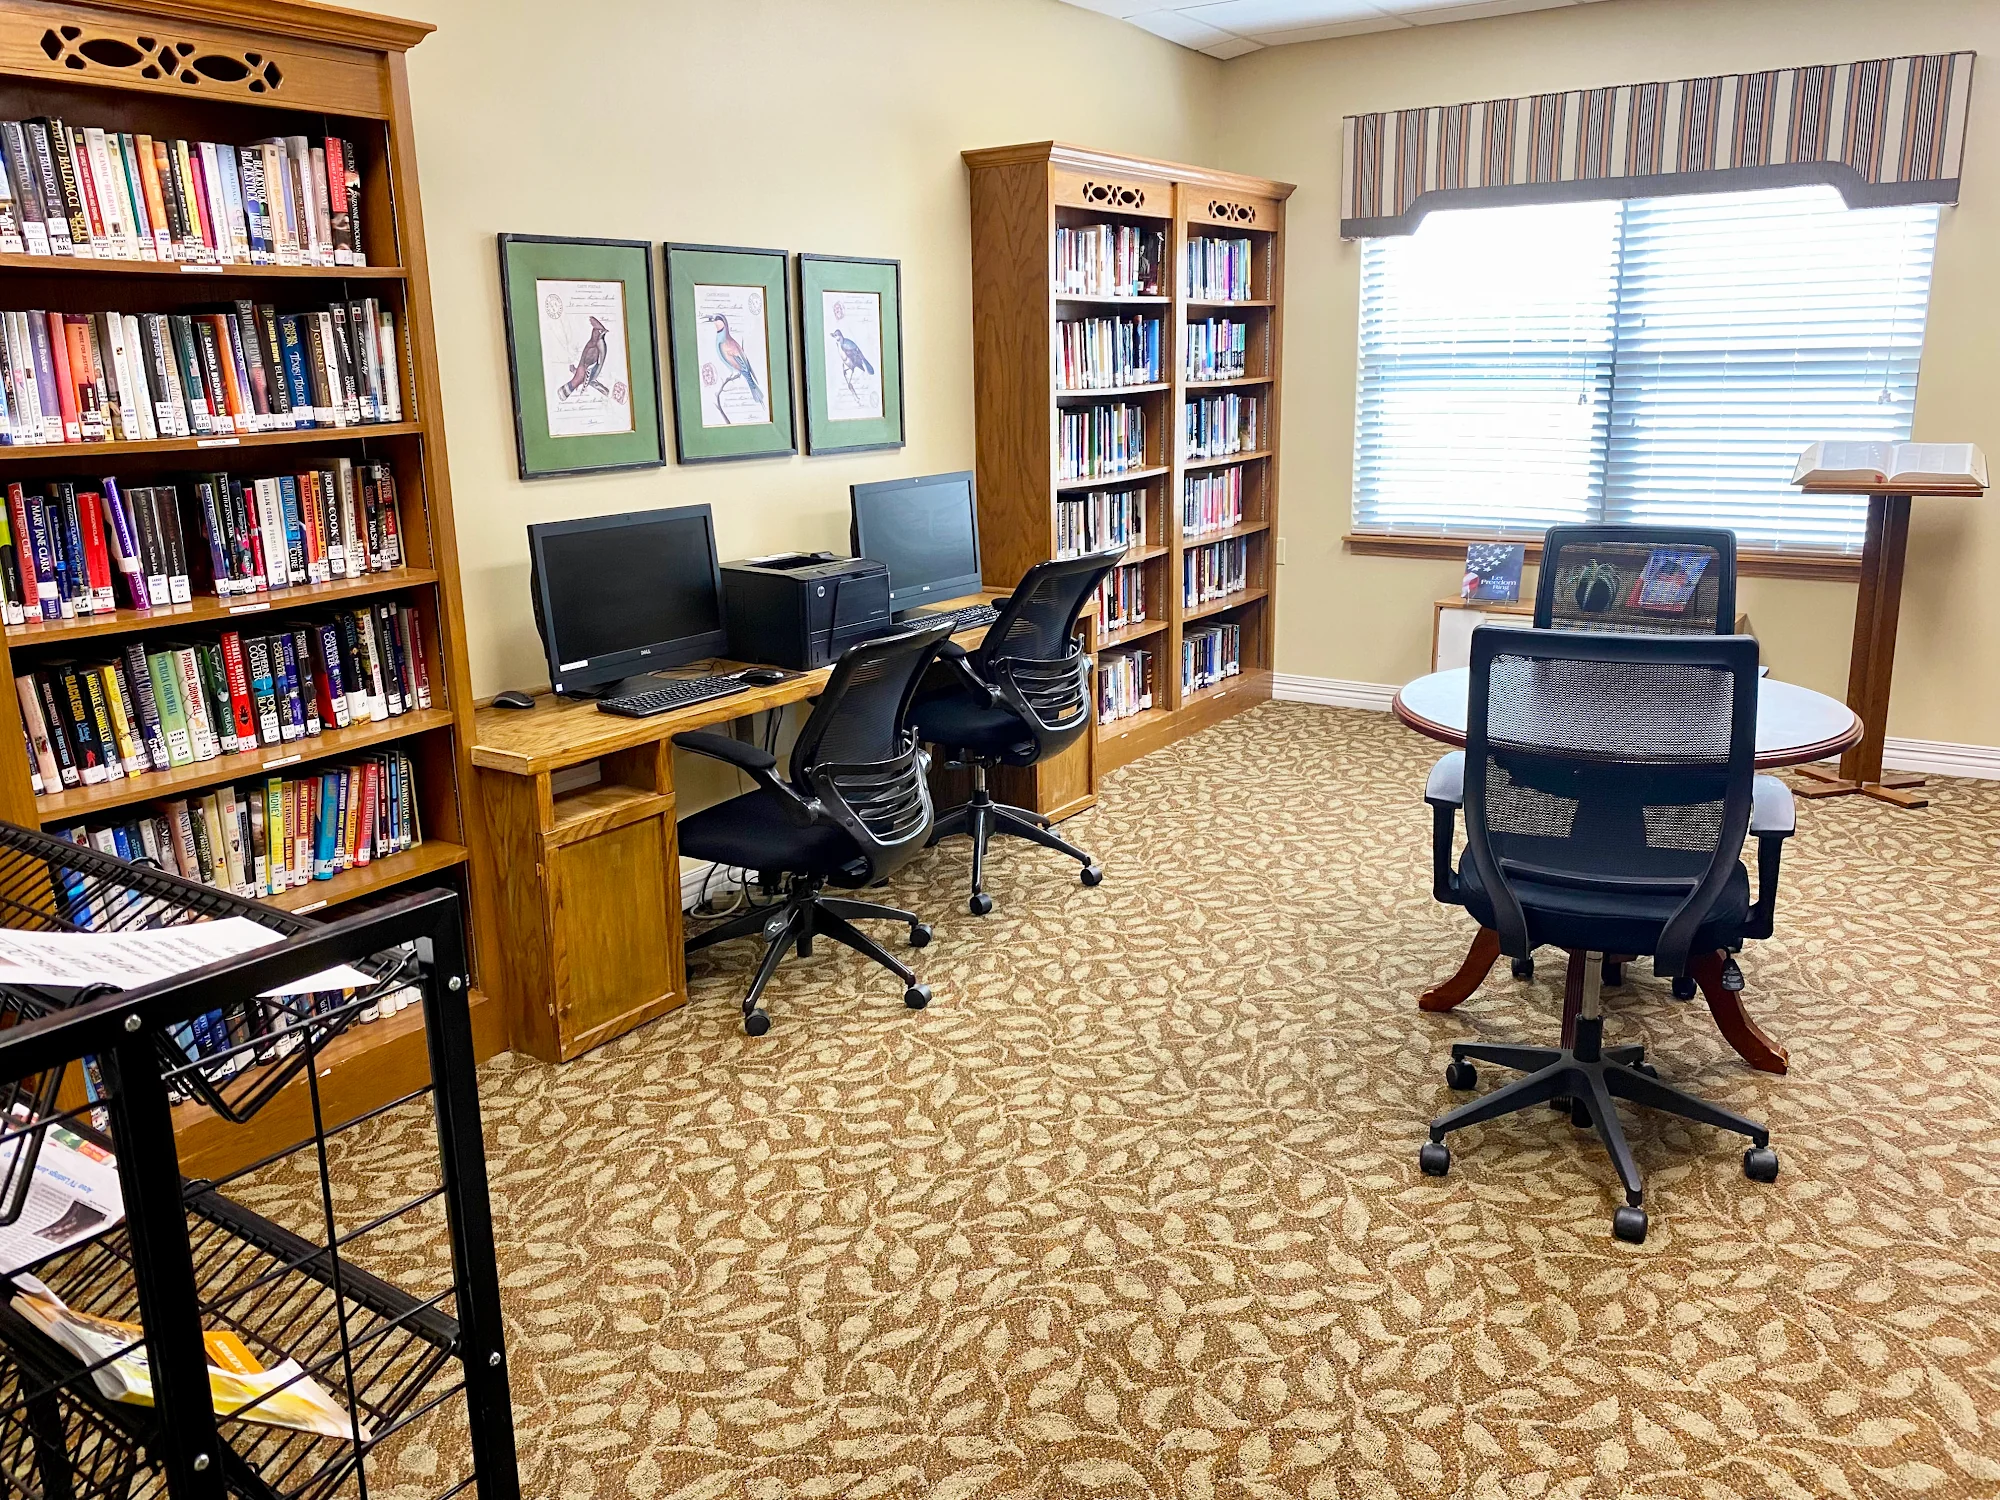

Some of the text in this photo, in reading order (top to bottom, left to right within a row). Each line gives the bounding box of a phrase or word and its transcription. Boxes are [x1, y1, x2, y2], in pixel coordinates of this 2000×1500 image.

[14, 153, 31, 190] BALDACCI
[33, 126, 57, 197] DAVID BALDACCI
[51, 120, 80, 207] DAVID BALDACCI
[241, 151, 258, 202] BLACKSTOCK
[253, 160, 268, 204] BLACKSTOCK
[339, 167, 347, 210] BOHJALIAN
[104, 184, 116, 216] BELGRAVIA
[74, 211, 90, 243] SPLIT
[159, 319, 169, 348] SANDRA
[240, 303, 256, 336] SANDRA
[267, 320, 277, 342] SANDRA
[91, 340, 99, 368] BROWNE
[164, 350, 175, 376] BROWN
[247, 338, 262, 368] BROWN
[270, 342, 280, 363] BROWN
[311, 328, 326, 374] JOURNEY
[204, 337, 216, 370] SANDRA
[212, 372, 224, 401] BROWN
[274, 365, 286, 390] BLIND
[168, 379, 180, 403] white
[67, 504, 75, 527] HIGGINS
[282, 479, 297, 531] HARLAN COBEN
[324, 474, 339, 537] ROBIN COOK
[13, 489, 39, 605] Carol Higgins Clark MOBBED
[31, 505, 51, 573] MARY JANE CLARK
[289, 548, 299, 569] CURE
[128, 647, 147, 683] PATRICIA
[248, 645, 262, 681] COULTER
[257, 643, 271, 679] CATHERINE
[272, 642, 286, 677] COULTER
[295, 635, 304, 660] COULTER
[325, 633, 335, 668] COULTER
[329, 630, 340, 665] CATHERINE
[229, 635, 247, 696] MICHAEL CRICHTON
[42, 683, 53, 702] MICHAEL
[64, 676, 78, 702] BLACK
[156, 655, 178, 716] PATRICIA CORNWELL
[182, 652, 201, 716] PATRICIA CORNWELL
[47, 703, 60, 726] CONNELLY
[69, 701, 86, 721] ECHO
[86, 673, 111, 743] MICHAEL CONNELLY
[281, 699, 290, 721] TAKE
[271, 792, 279, 818] MONEY
[350, 785, 358, 810] EVANOVICH
[363, 772, 377, 835] JANET EVANOVICH
[400, 779, 410, 820] EVANOVICH
[178, 810, 196, 859] JANET DAILEY
[285, 806, 293, 836] EVANOVICH
[300, 802, 308, 834] EVANOVICH
